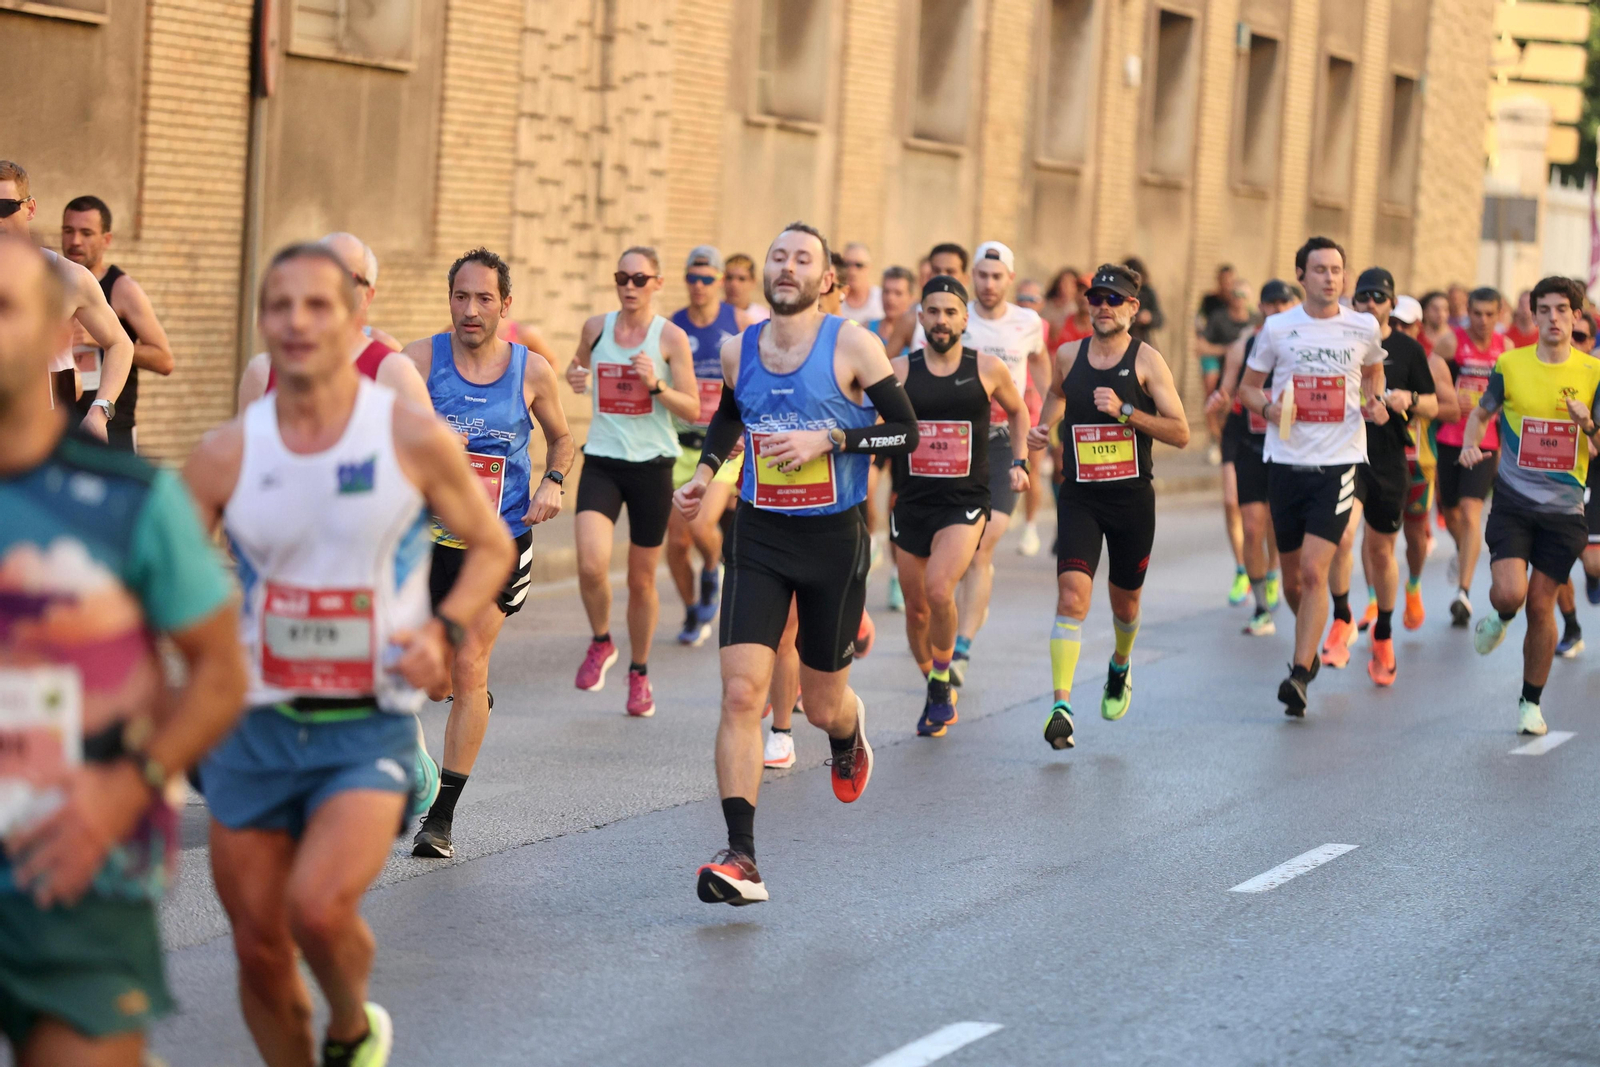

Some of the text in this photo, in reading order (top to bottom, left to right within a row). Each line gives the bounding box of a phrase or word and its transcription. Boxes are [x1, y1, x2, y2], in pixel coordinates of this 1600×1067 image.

[446, 414, 485, 427] CLUB
[870, 433, 907, 448] TERREX
[929, 441, 948, 450] 433
[1092, 444, 1117, 454] 1013
